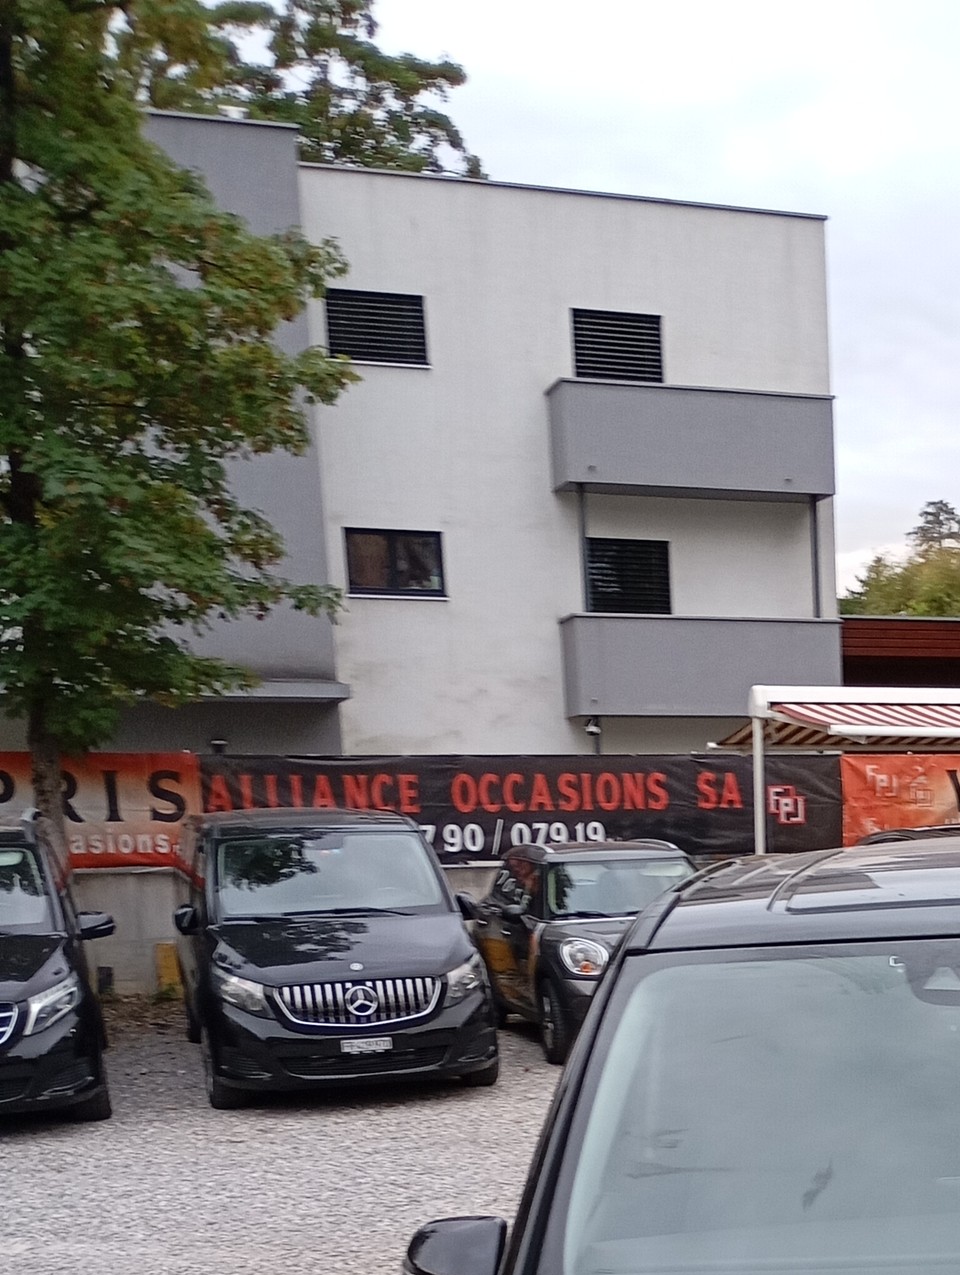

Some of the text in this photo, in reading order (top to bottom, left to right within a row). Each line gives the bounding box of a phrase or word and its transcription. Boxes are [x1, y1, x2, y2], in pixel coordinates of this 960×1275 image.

[203, 772, 744, 813] ALLIANCE OCCASIONS SA
